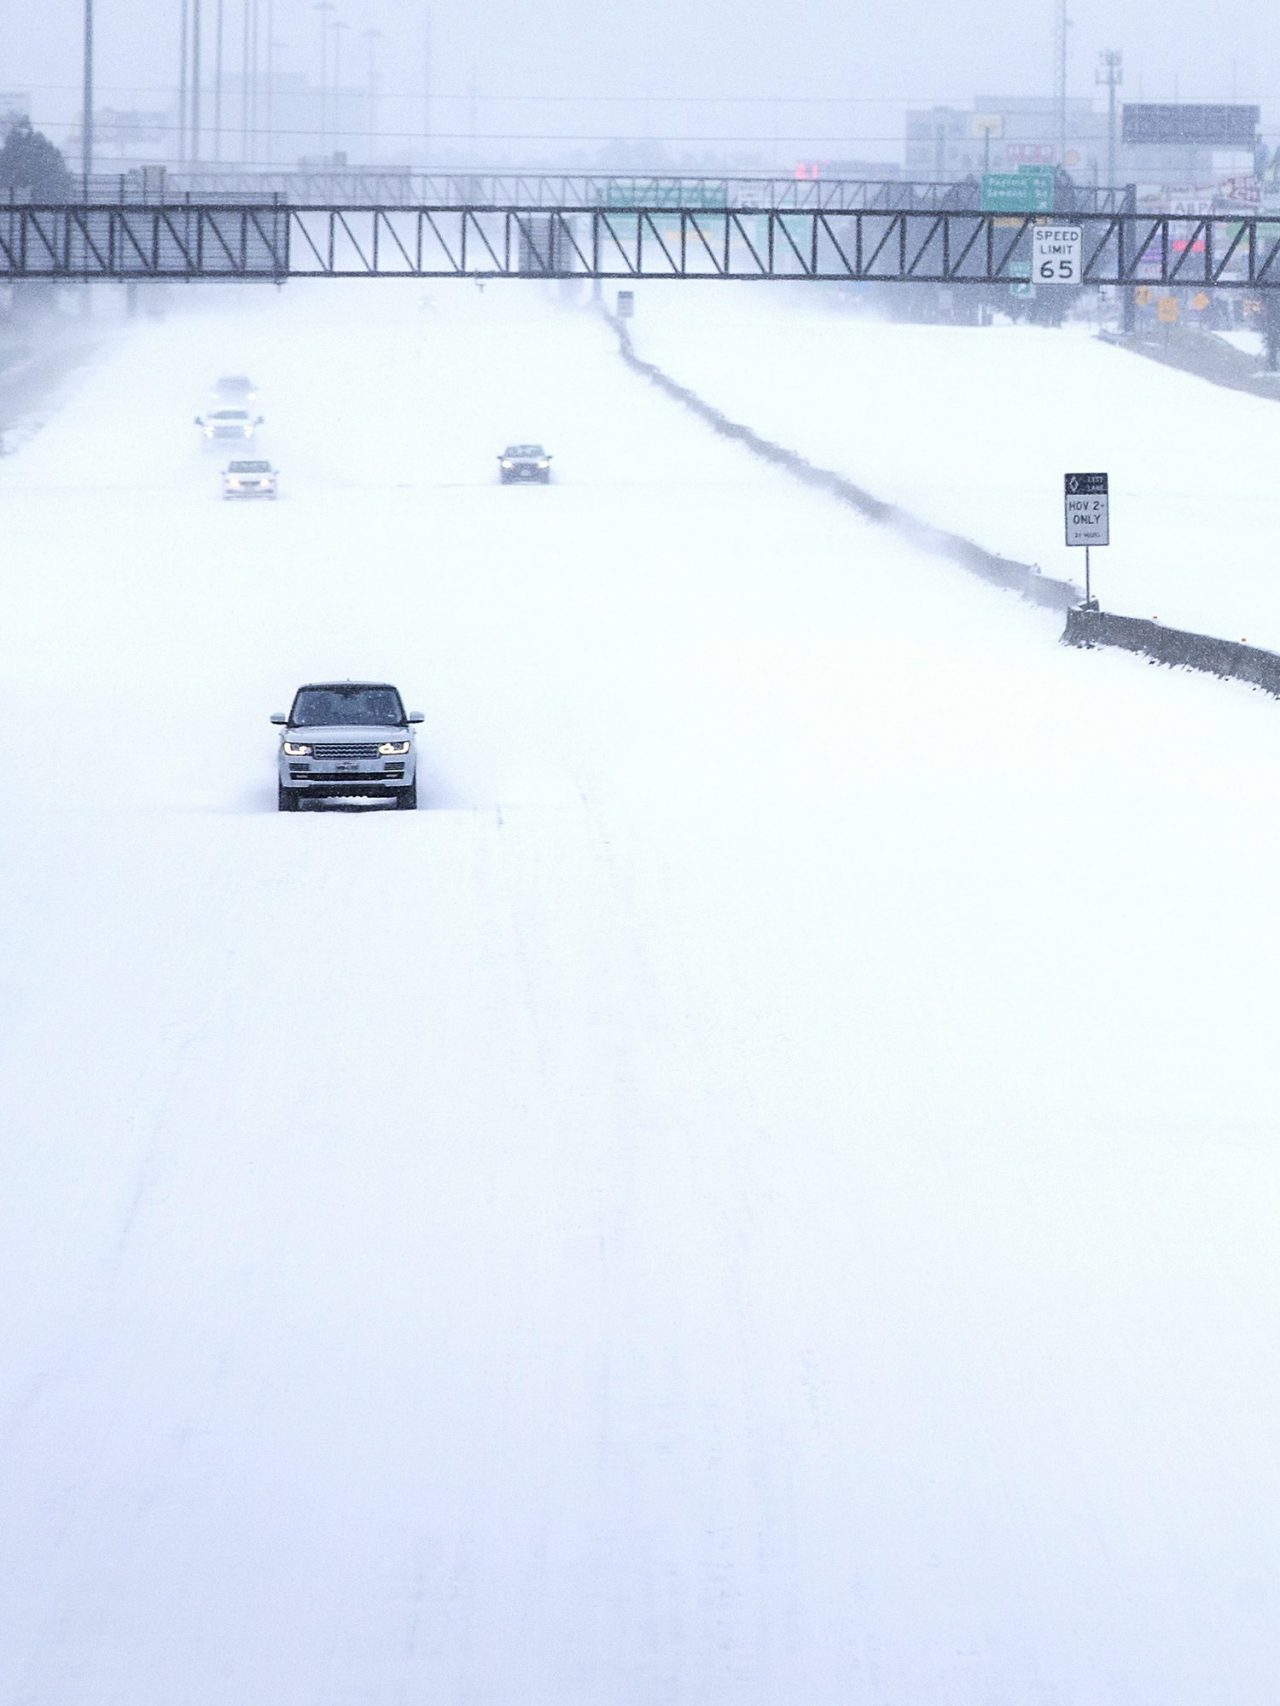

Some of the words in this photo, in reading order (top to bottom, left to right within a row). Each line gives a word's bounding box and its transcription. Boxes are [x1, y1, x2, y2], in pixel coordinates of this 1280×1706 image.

[1036, 230, 1079, 241] SPEED
[1040, 245, 1073, 255] LIMIT
[1040, 260, 1073, 279] 65
[1069, 500, 1090, 511] HOV
[1072, 514, 1101, 525] ONLY
